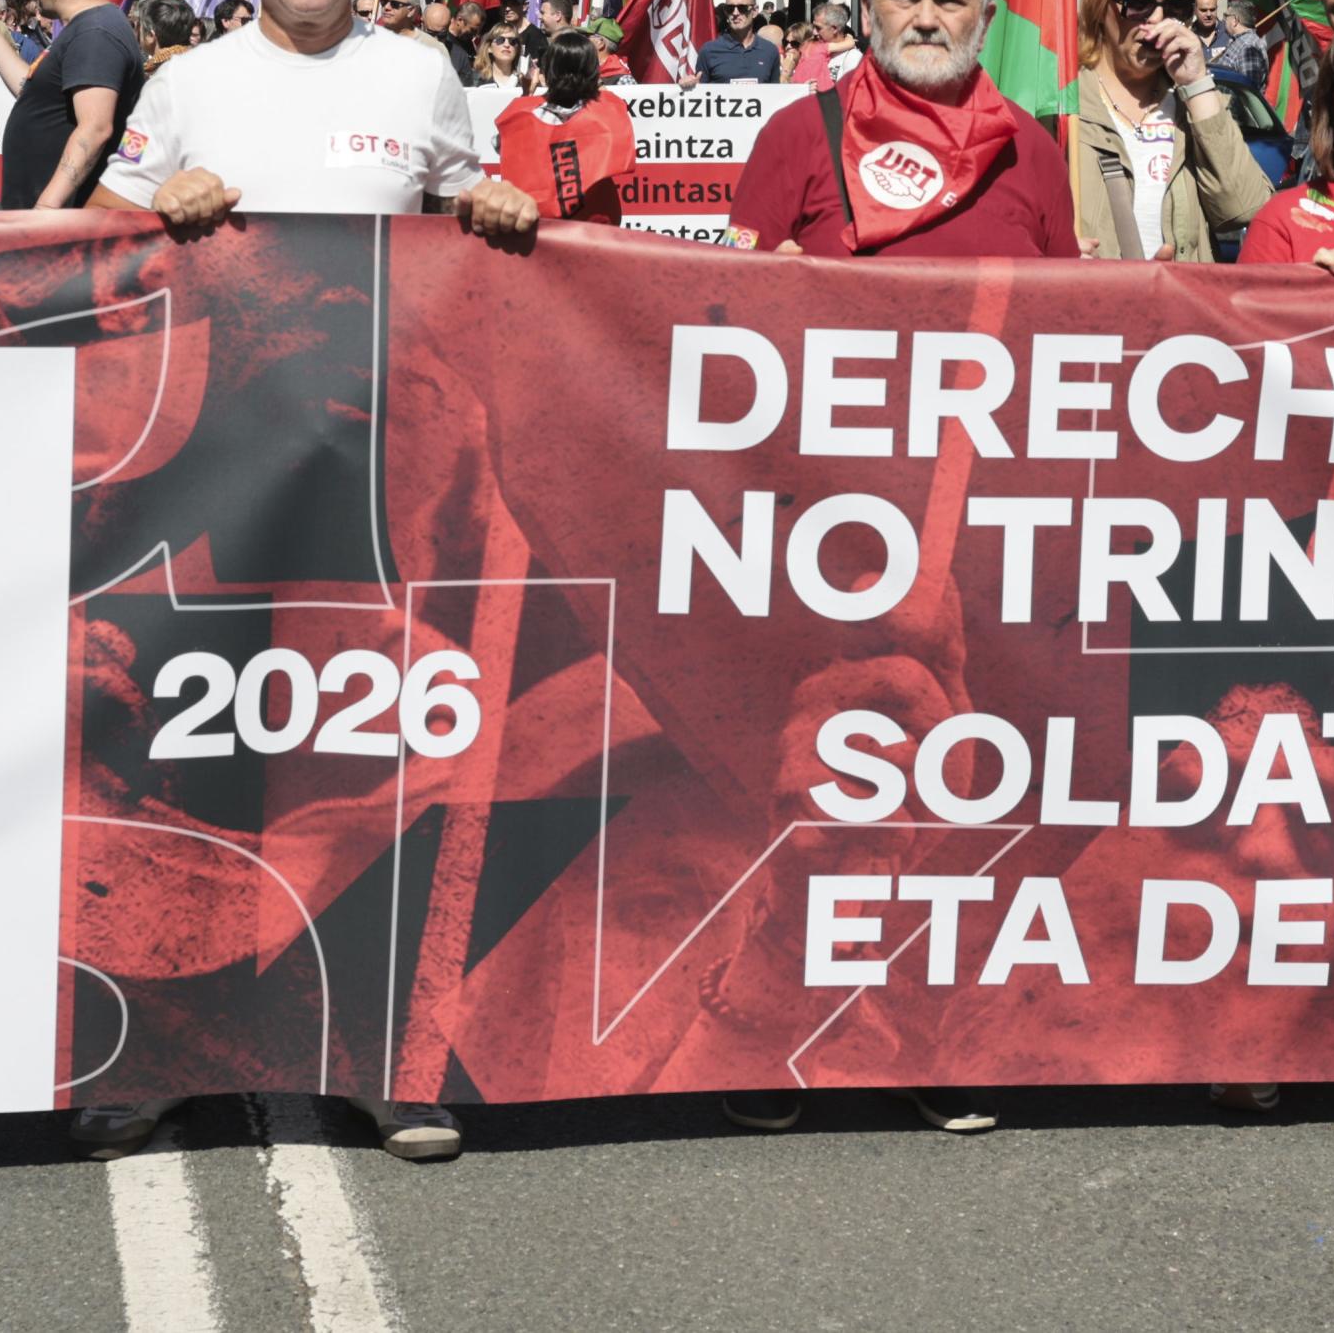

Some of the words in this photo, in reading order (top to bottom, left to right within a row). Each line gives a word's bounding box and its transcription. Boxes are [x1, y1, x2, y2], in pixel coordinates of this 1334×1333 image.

[874, 147, 938, 190] UGT
[1142, 123, 1175, 141] UG
[657, 488, 920, 622] NO
[148, 648, 481, 760] 2026
[804, 874, 1091, 988] ETA
